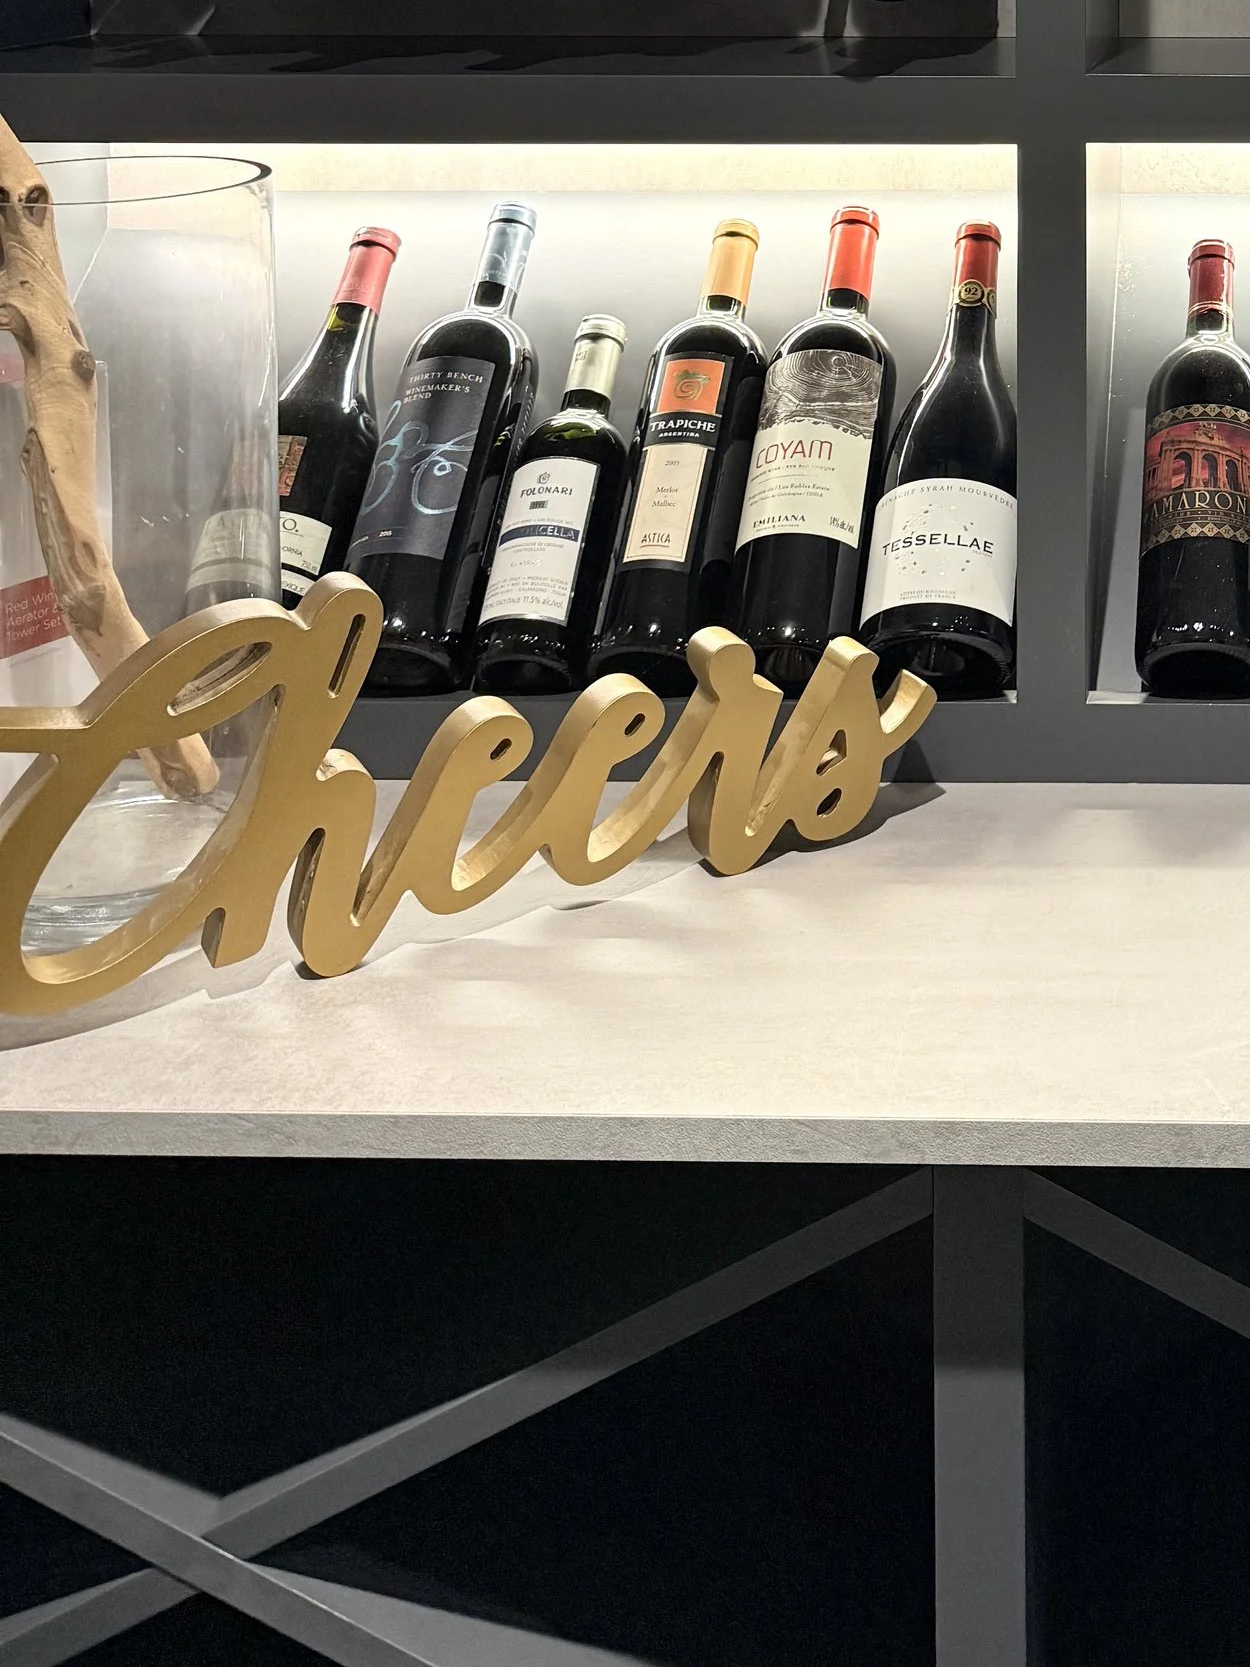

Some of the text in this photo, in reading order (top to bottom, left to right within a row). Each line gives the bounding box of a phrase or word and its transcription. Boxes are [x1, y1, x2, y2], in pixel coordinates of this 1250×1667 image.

[964, 286, 978, 296] 92
[409, 371, 484, 384] THIRTY BENCH
[405, 383, 471, 396] WINEMAKER'S
[403, 392, 432, 404] BLEND
[649, 419, 716, 433] TRAPICHE
[756, 439, 833, 469] COYAM
[520, 486, 573, 498] FOLONARI
[920, 485, 953, 493] SYRAH
[753, 514, 806, 528] EMILIANA
[640, 532, 671, 544] ASTICA
[882, 533, 994, 556] TESSELLAE
[5, 597, 29, 615] Red
[6, 607, 49, 629] Aerator
[6, 616, 61, 641] Tower Set
[0, 571, 936, 1018] Cheers
